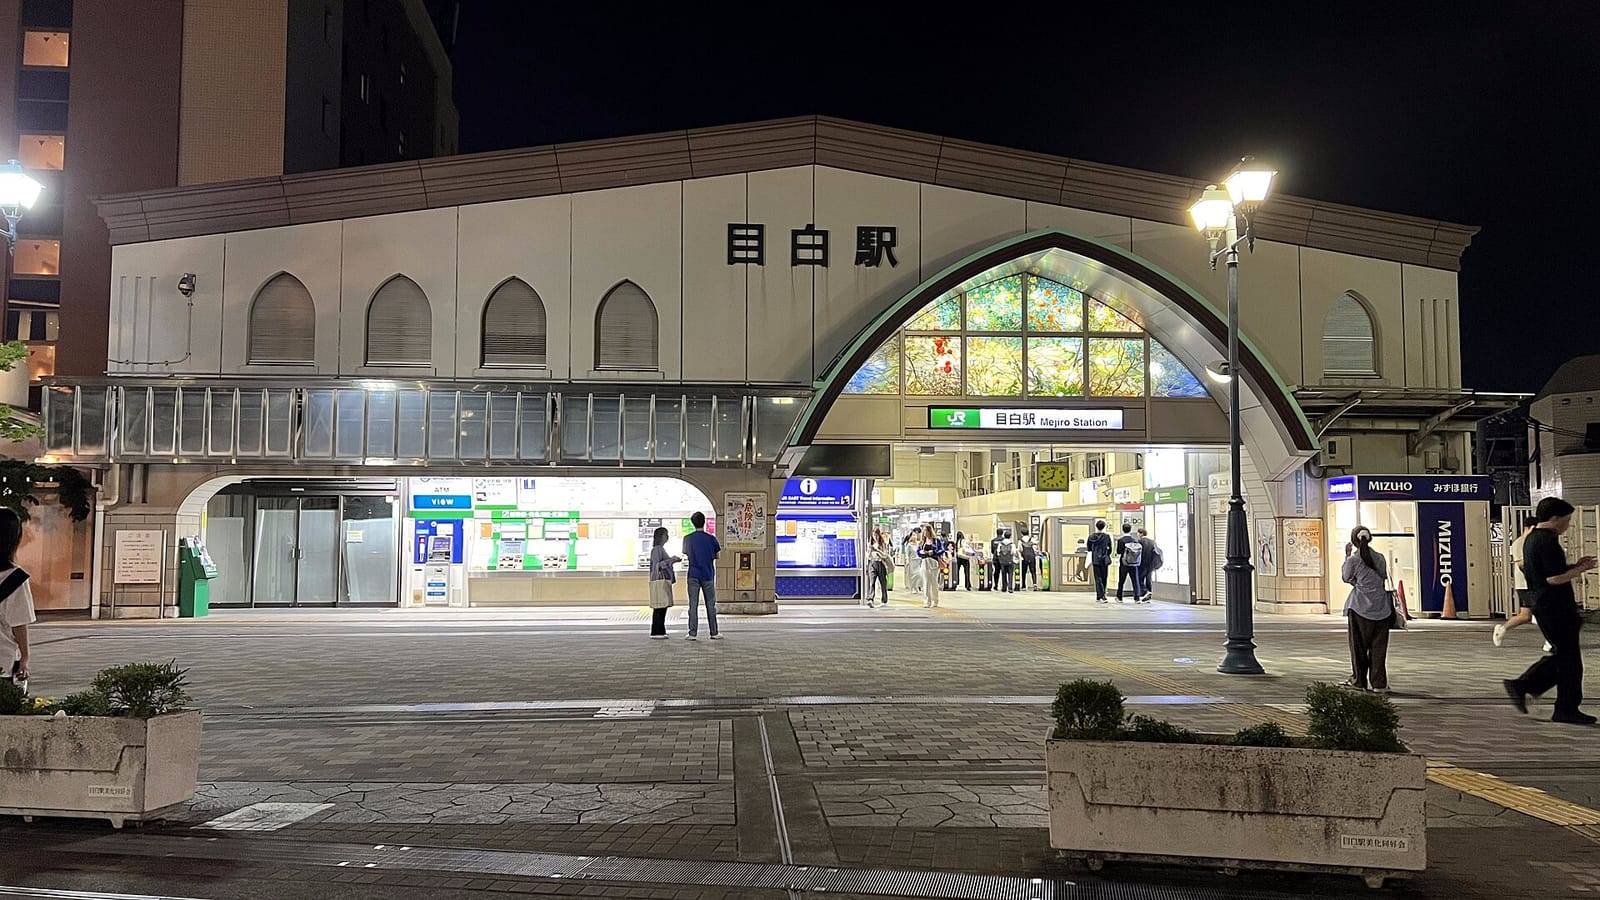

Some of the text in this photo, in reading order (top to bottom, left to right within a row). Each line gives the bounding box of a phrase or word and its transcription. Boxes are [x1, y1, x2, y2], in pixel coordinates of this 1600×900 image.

[727, 223, 898, 268] 目白駅
[947, 411, 966, 423] JR
[996, 412, 1108, 428] 目白駅 Mejiro Station
[1368, 481, 1413, 491] MIZUHO
[1433, 483, 1479, 493] みずほ銀行
[1438, 520, 1453, 588] MIZUHO
